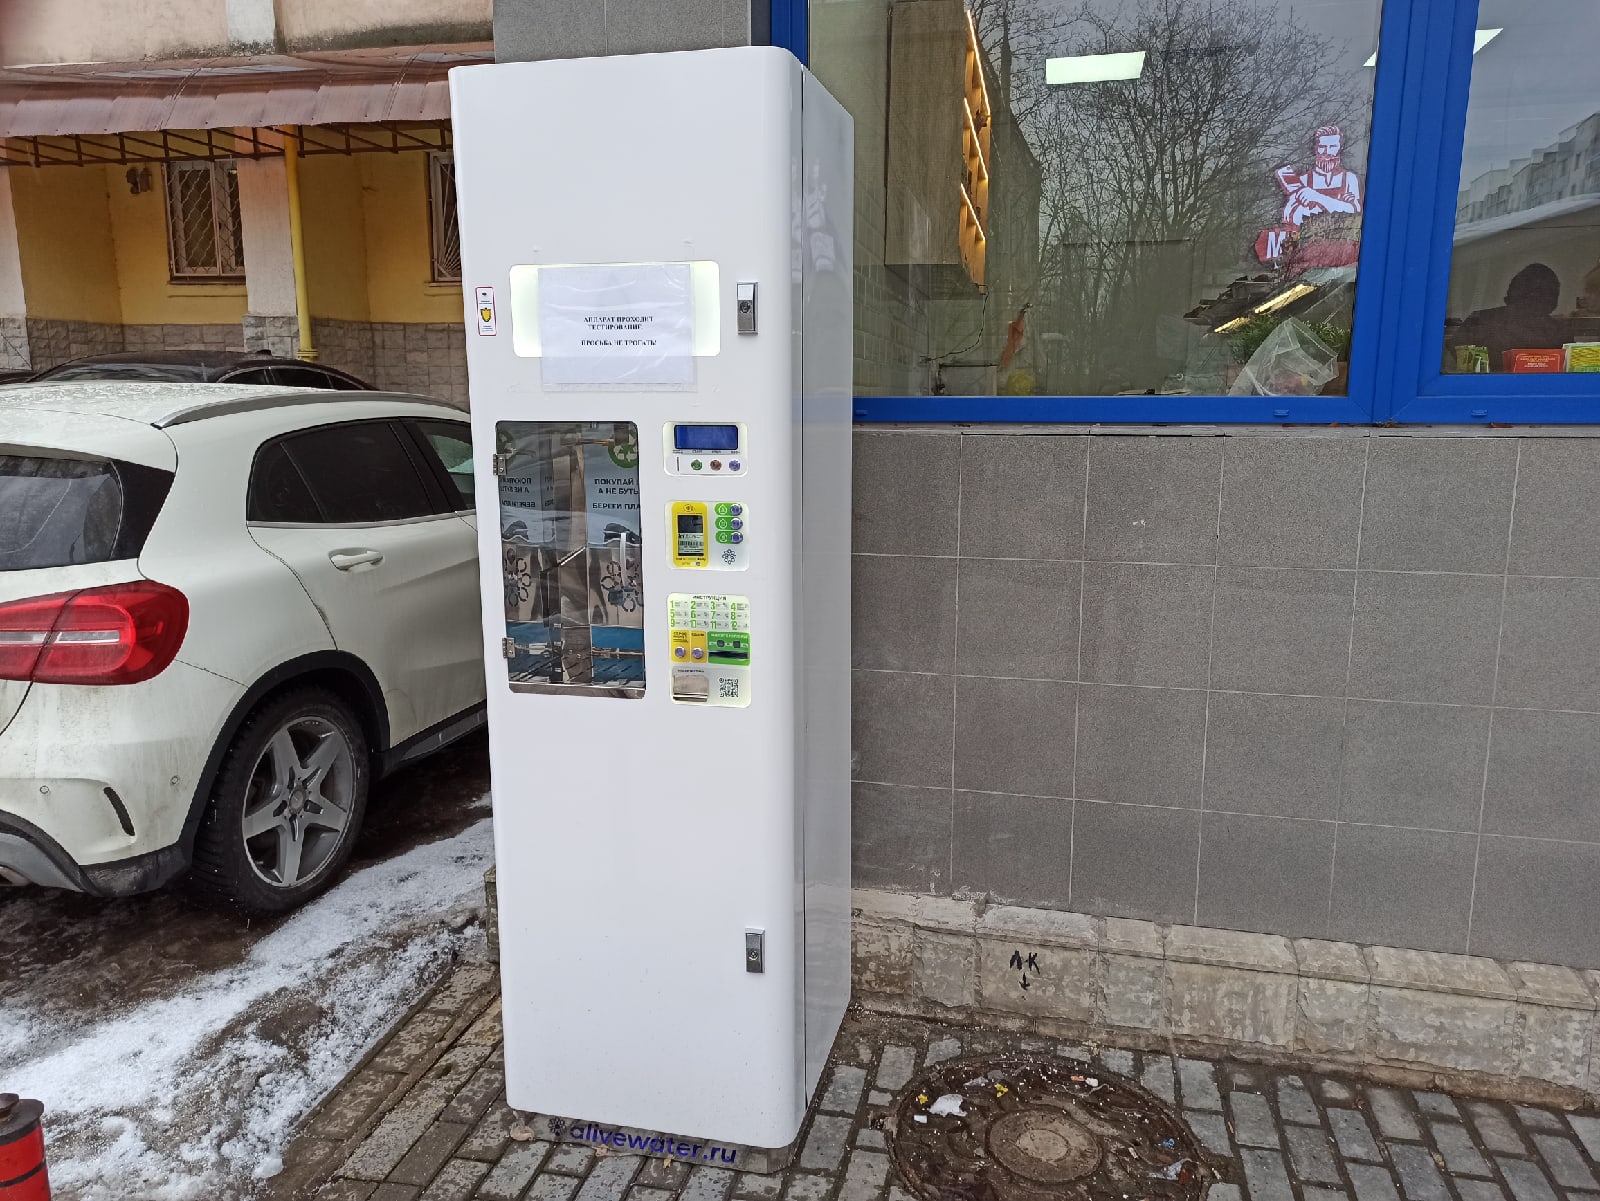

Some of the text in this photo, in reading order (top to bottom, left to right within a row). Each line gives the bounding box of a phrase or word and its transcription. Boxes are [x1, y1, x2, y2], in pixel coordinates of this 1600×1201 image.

[594, 477, 634, 486] ПОКУПАЙ
[605, 487, 617, 495] НЕ
[690, 601, 697, 609] 2
[710, 601, 716, 610] 3
[730, 603, 736, 611] 4
[690, 610, 696, 618] 6
[711, 611, 716, 619] 7
[730, 612, 736, 620] 8
[710, 621, 717, 629] 11
[570, 1124, 737, 1163] alivewater.ru
